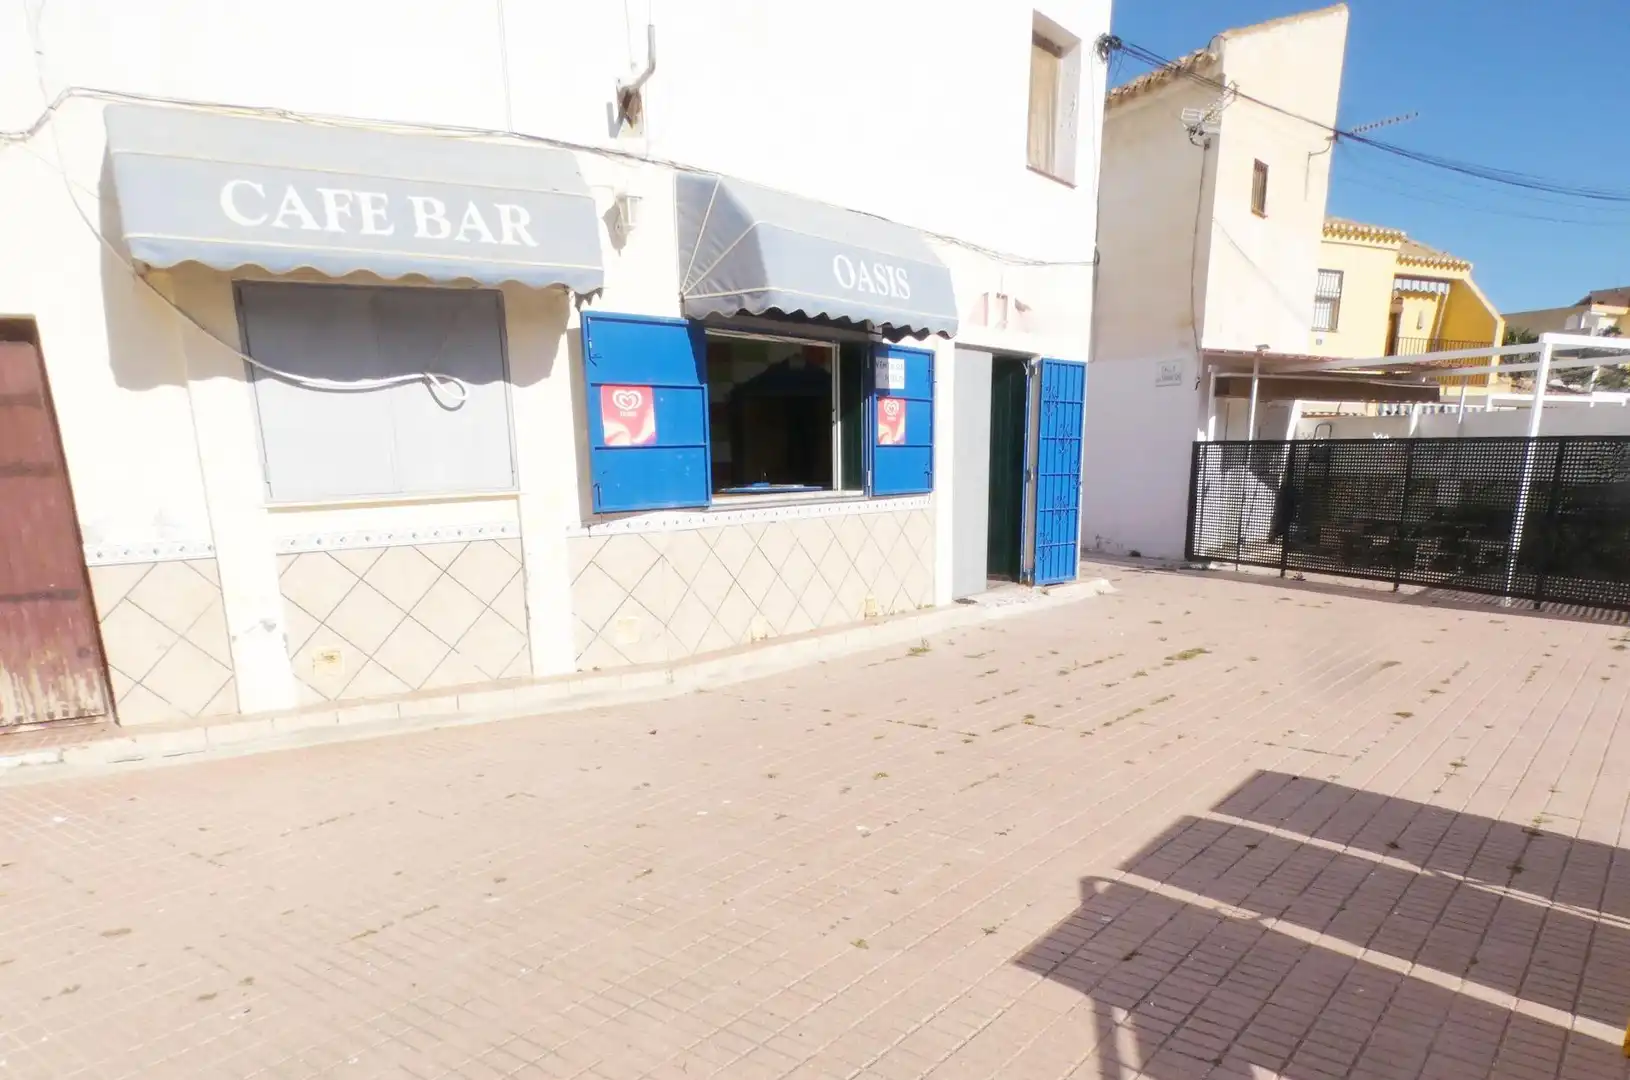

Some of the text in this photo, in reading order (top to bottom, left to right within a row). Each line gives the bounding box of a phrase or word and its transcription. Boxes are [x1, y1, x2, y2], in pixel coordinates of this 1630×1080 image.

[219, 179, 540, 247] CAFE BAR
[832, 253, 911, 300] OASIS
